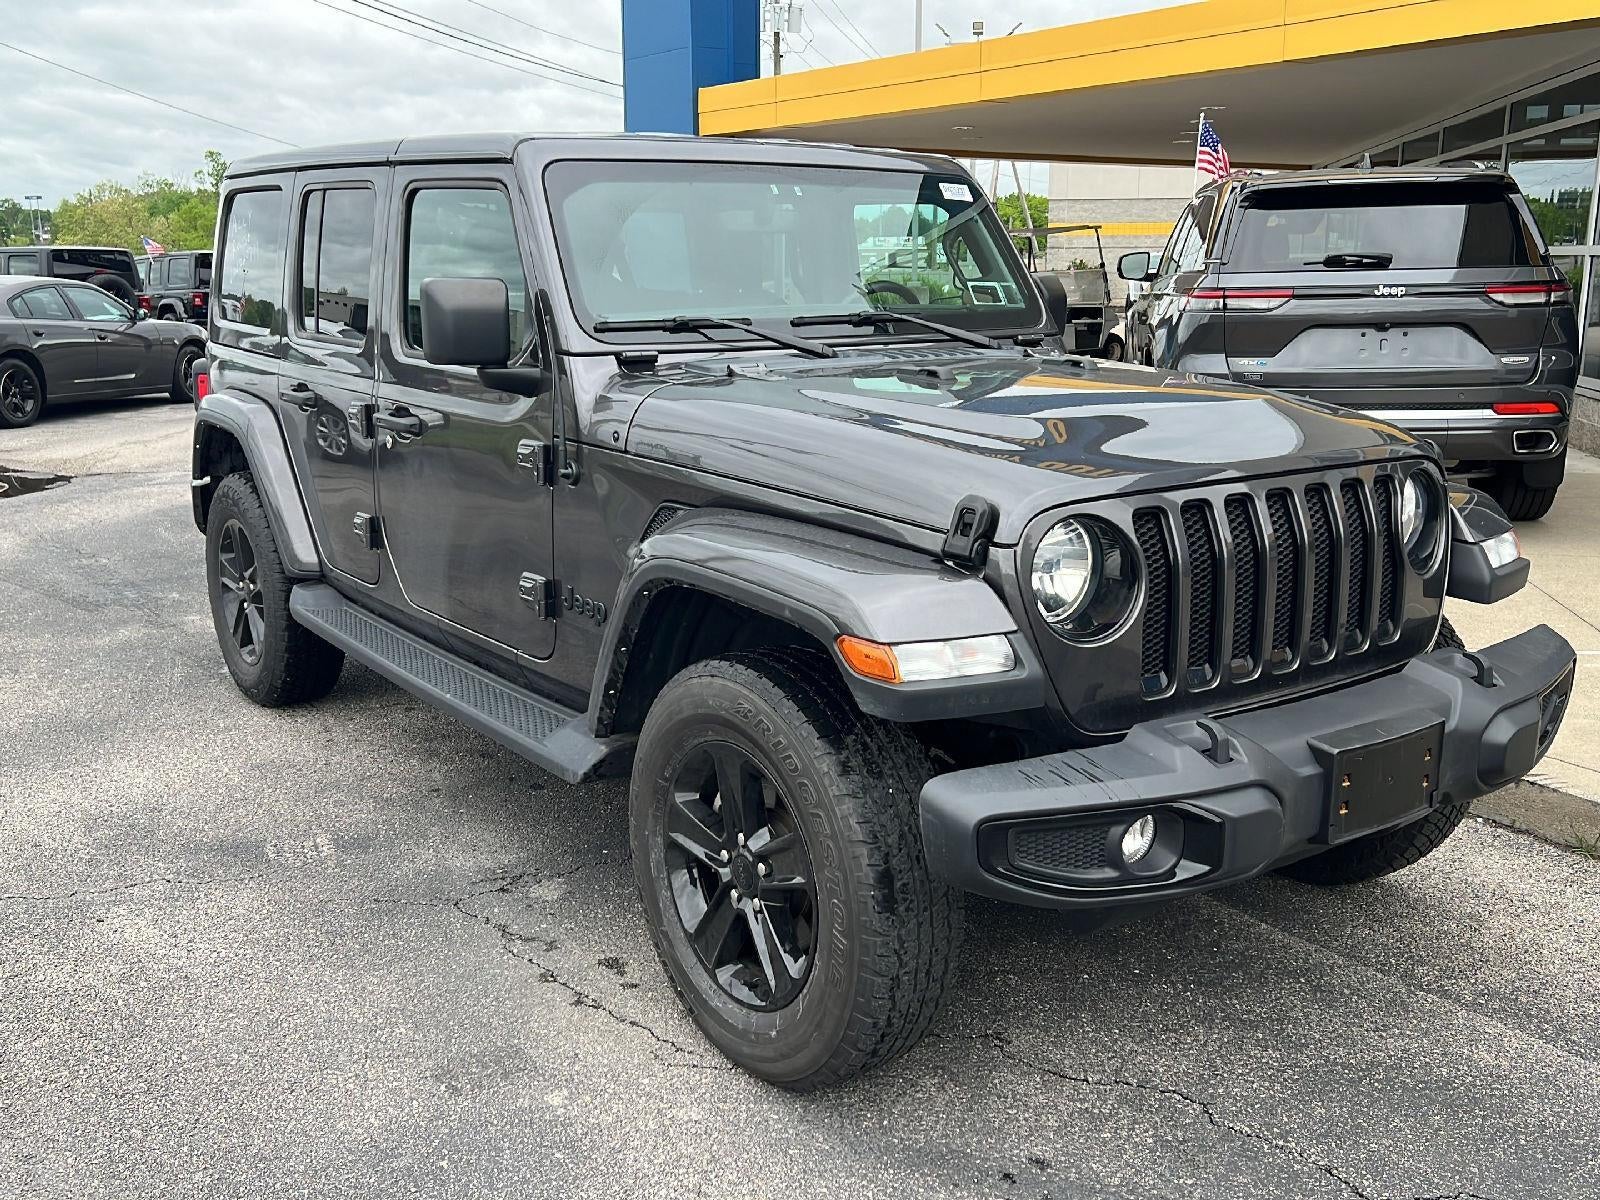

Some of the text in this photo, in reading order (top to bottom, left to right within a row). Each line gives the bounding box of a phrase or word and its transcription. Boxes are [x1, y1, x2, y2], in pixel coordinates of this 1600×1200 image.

[1374, 284, 1406, 298] Jeep
[560, 584, 608, 628] Jeep
[730, 698, 848, 994] BRIDGESTONE
